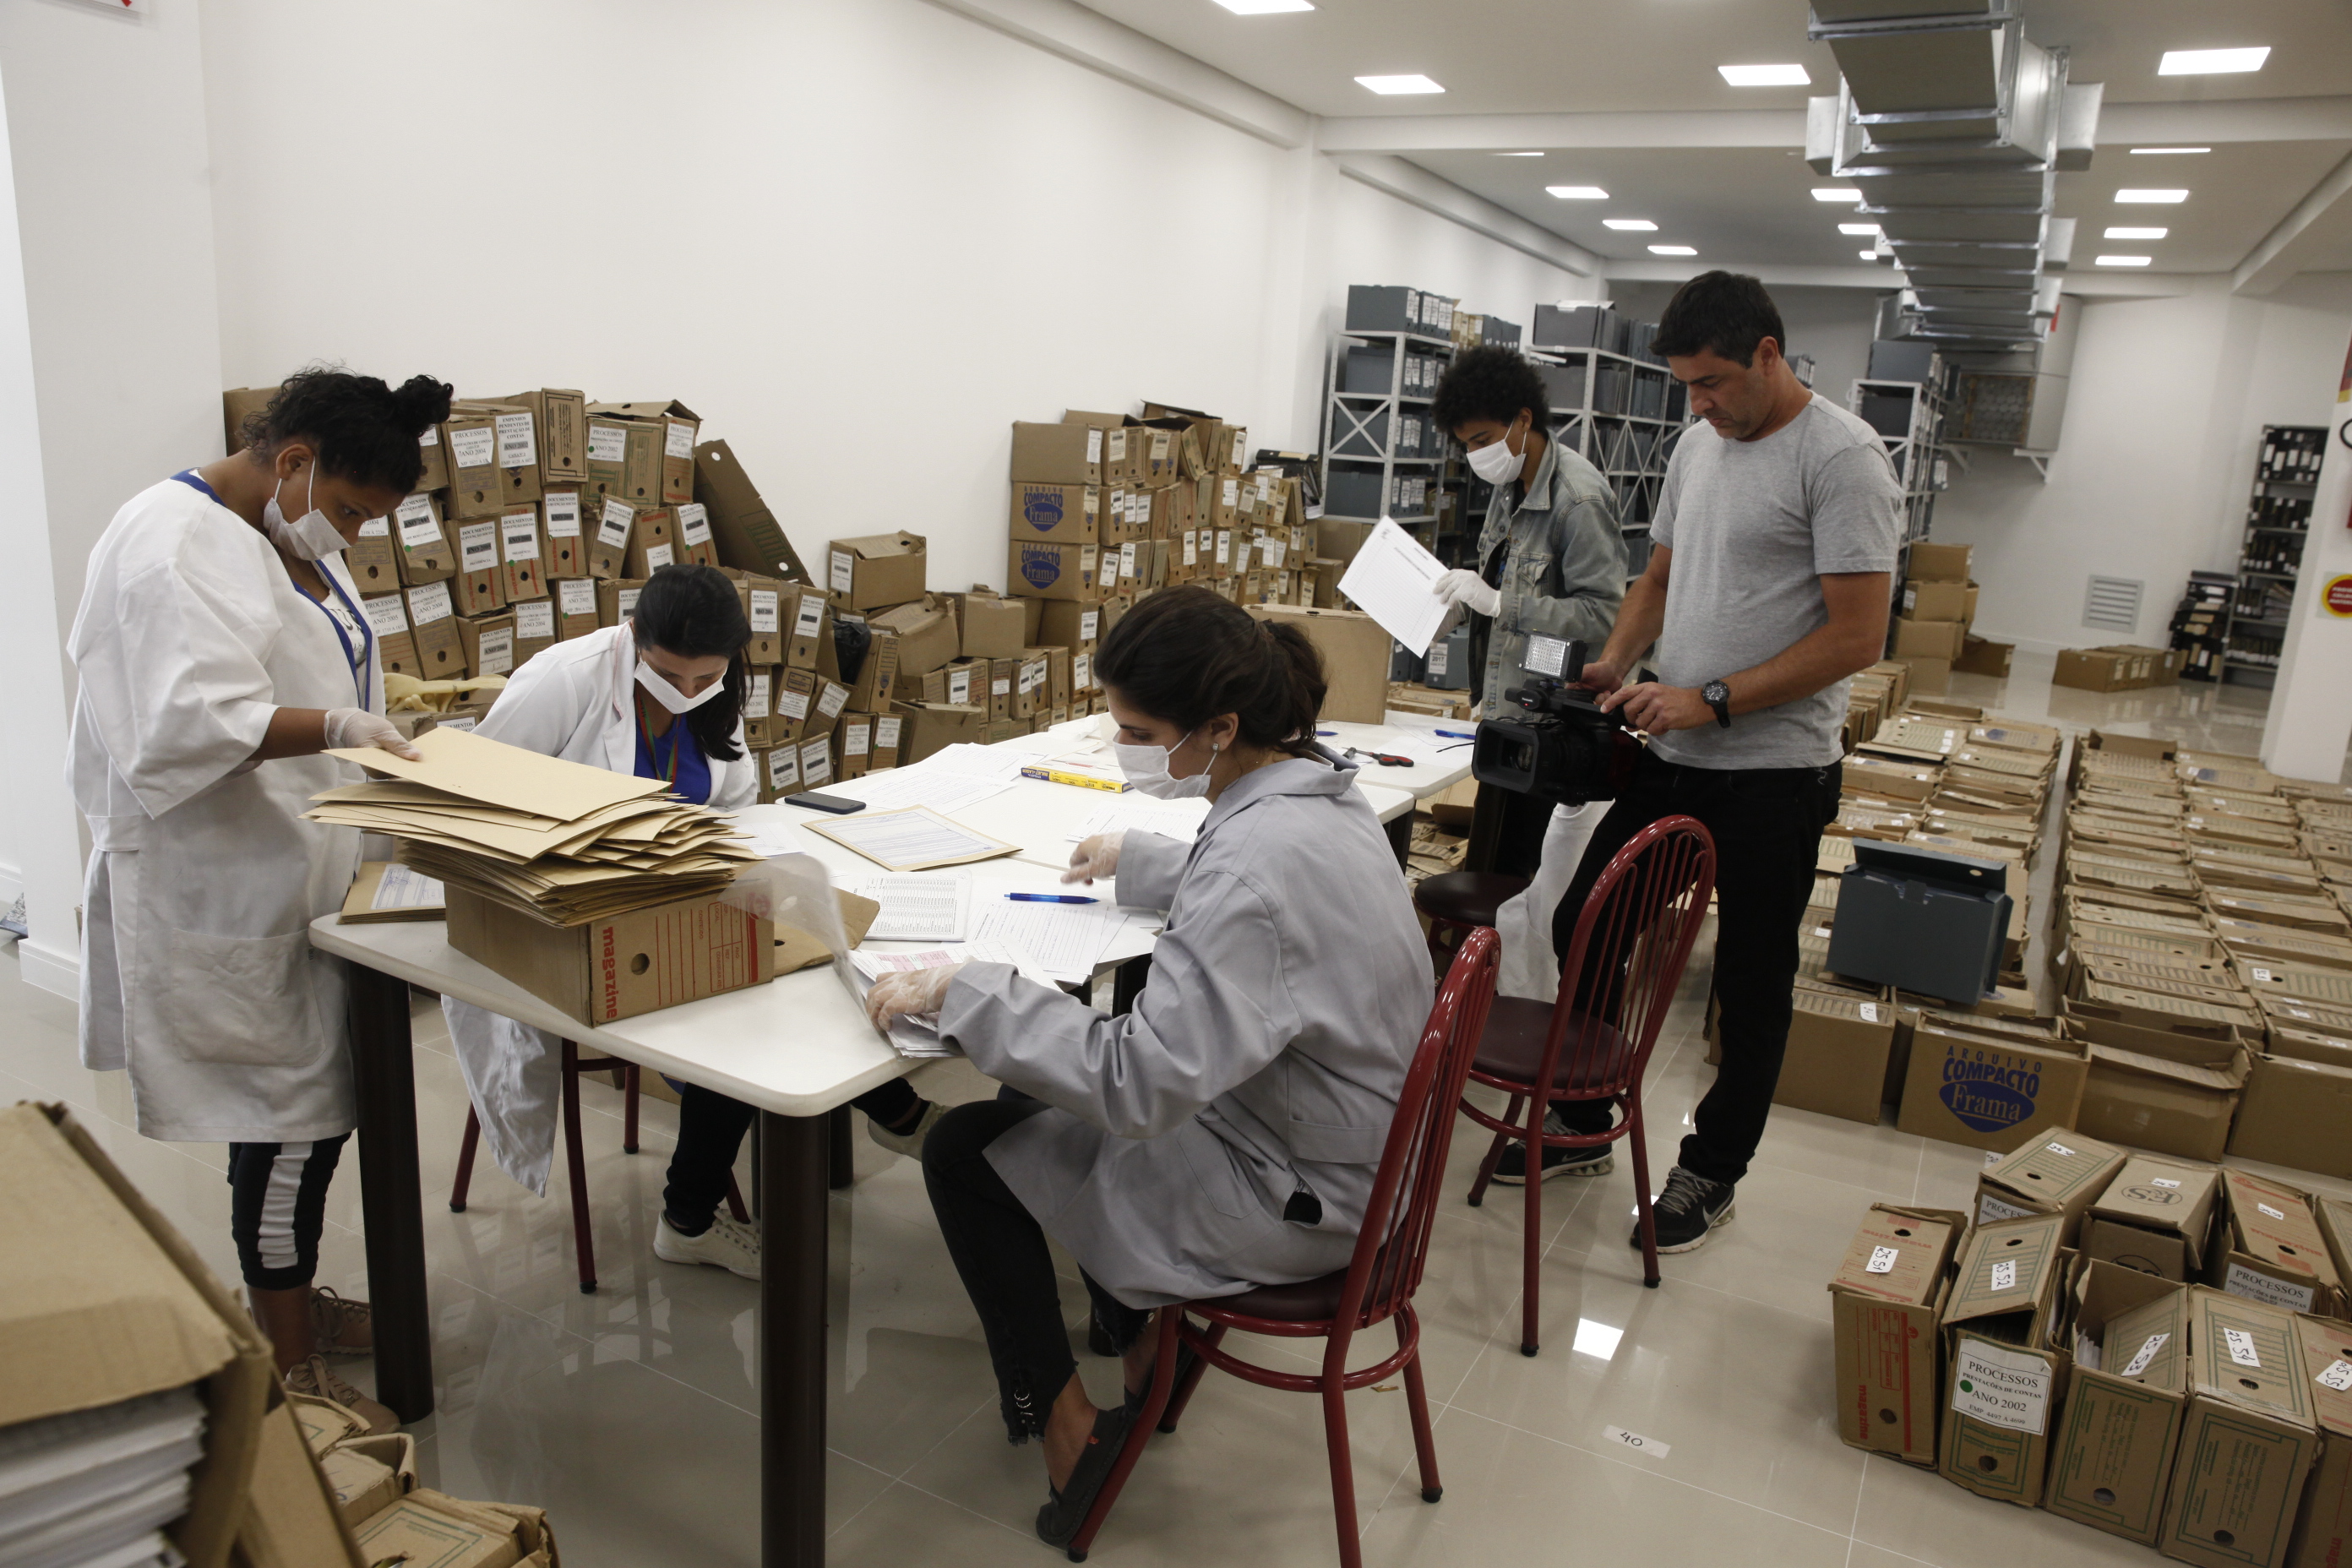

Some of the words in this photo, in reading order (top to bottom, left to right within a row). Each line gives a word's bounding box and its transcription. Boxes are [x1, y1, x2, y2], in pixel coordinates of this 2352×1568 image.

[455, 430, 487, 439] PROCESSOS
[593, 429, 623, 438] PROCESSOS
[1024, 493, 1063, 506] COMPACTO
[1029, 505, 1059, 522] Frama
[462, 525, 493, 536] DOCUMENTOS
[1021, 550, 1060, 566] COMPACTO
[1026, 564, 1055, 580] Frama
[411, 584, 442, 596] PROCESSOS
[365, 599, 399, 610] PROCESSOS
[419, 606, 431, 614] ANO
[482, 629, 510, 638] DOCUMENTOS
[602, 926, 618, 1019] magazine
[1947, 1046, 2042, 1072] ARQUIVO
[1943, 1058, 2039, 1098] COMPACTO
[1951, 1084, 2021, 1121] Frama
[1862, 1229, 1932, 1249] magazine
[2250, 1228, 2322, 1256] magazine
[2236, 1270, 2305, 1298] PROCESSOS
[2229, 1279, 2268, 1298] PRESTAÇÕES
[2279, 1297, 2307, 1309] CONTAS
[1968, 1361, 2038, 1387] PROCESSOS
[1963, 1372, 2003, 1391] PRESTAÇÕES
[2014, 1388, 2041, 1398] CONTAS
[1972, 1390, 1998, 1405] ANO
[2001, 1399, 2027, 1412] 2002
[1858, 1385, 1869, 1440] magazine
[1986, 1411, 2001, 1420] 4497
[1620, 1432, 1642, 1446] 40
